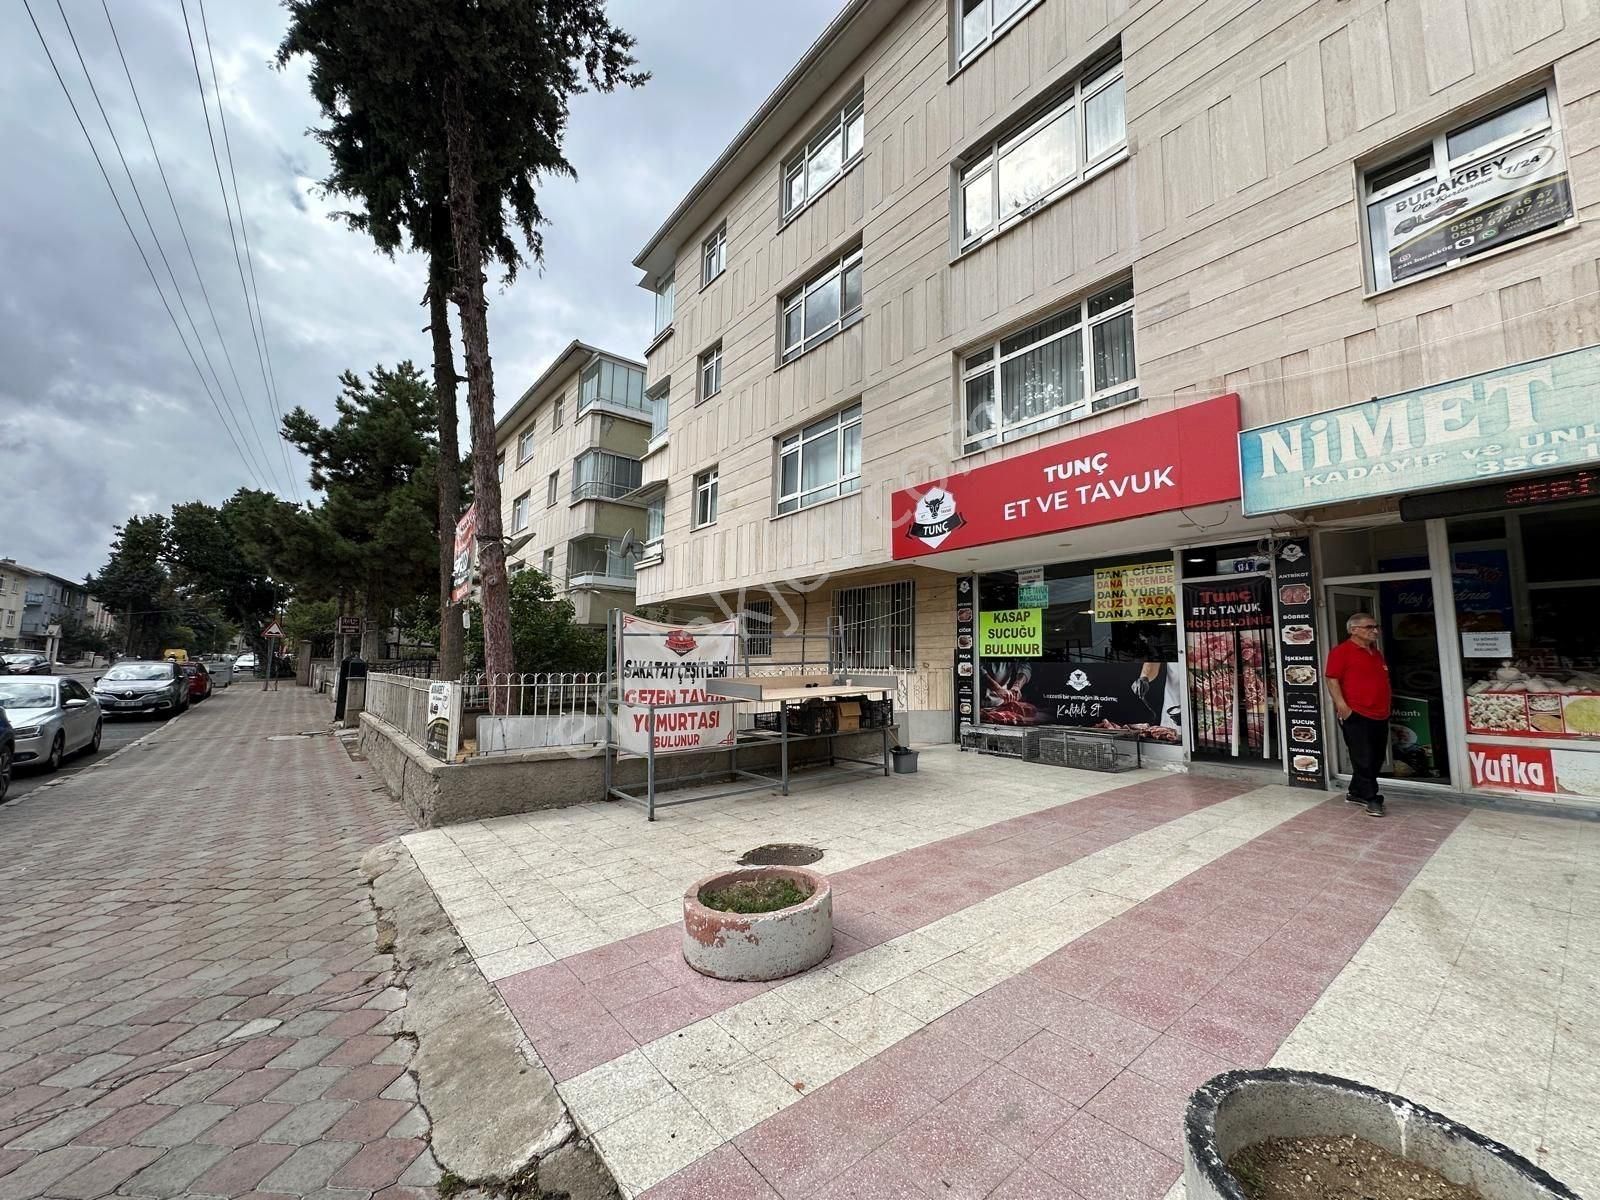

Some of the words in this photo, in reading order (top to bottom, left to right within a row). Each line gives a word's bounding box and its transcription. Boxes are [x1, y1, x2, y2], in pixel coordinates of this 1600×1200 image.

[1503, 154, 1542, 175] 7/24
[1395, 157, 1508, 213] BURAKBEY
[1450, 215, 1483, 232] 0539
[1451, 223, 1484, 240] 0532
[1515, 205, 1532, 216] 07
[1044, 452, 1109, 483] TUNÇ
[1303, 451, 1446, 488] KADAYIF
[1004, 499, 1031, 521] ET
[1036, 493, 1069, 514] VE
[1076, 465, 1175, 506] TAVUK
[923, 521, 949, 536] TUNÇ
[1097, 570, 1128, 579] DANA
[1097, 580, 1122, 589] DANA
[1097, 590, 1127, 599] DANA
[1131, 586, 1173, 597] YÜREK
[1098, 598, 1132, 608] KUZU
[1138, 595, 1174, 608] PAÇA
[1193, 607, 1206, 616] ET
[1209, 607, 1217, 615] &
[1219, 602, 1262, 615] TAVUK
[994, 611, 1030, 623] KASAP
[1097, 609, 1132, 618] DANA
[1138, 607, 1175, 618] PAÇA
[988, 624, 1035, 639] SUCUĞU
[985, 643, 1040, 654] BULUNUR
[624, 659, 675, 680] SAKATAT
[678, 656, 728, 684] ÇEŞİTLERİ
[624, 688, 676, 707] GEZEN
[654, 734, 700, 748] BULUNUR
[1469, 752, 1545, 786] Yufka
